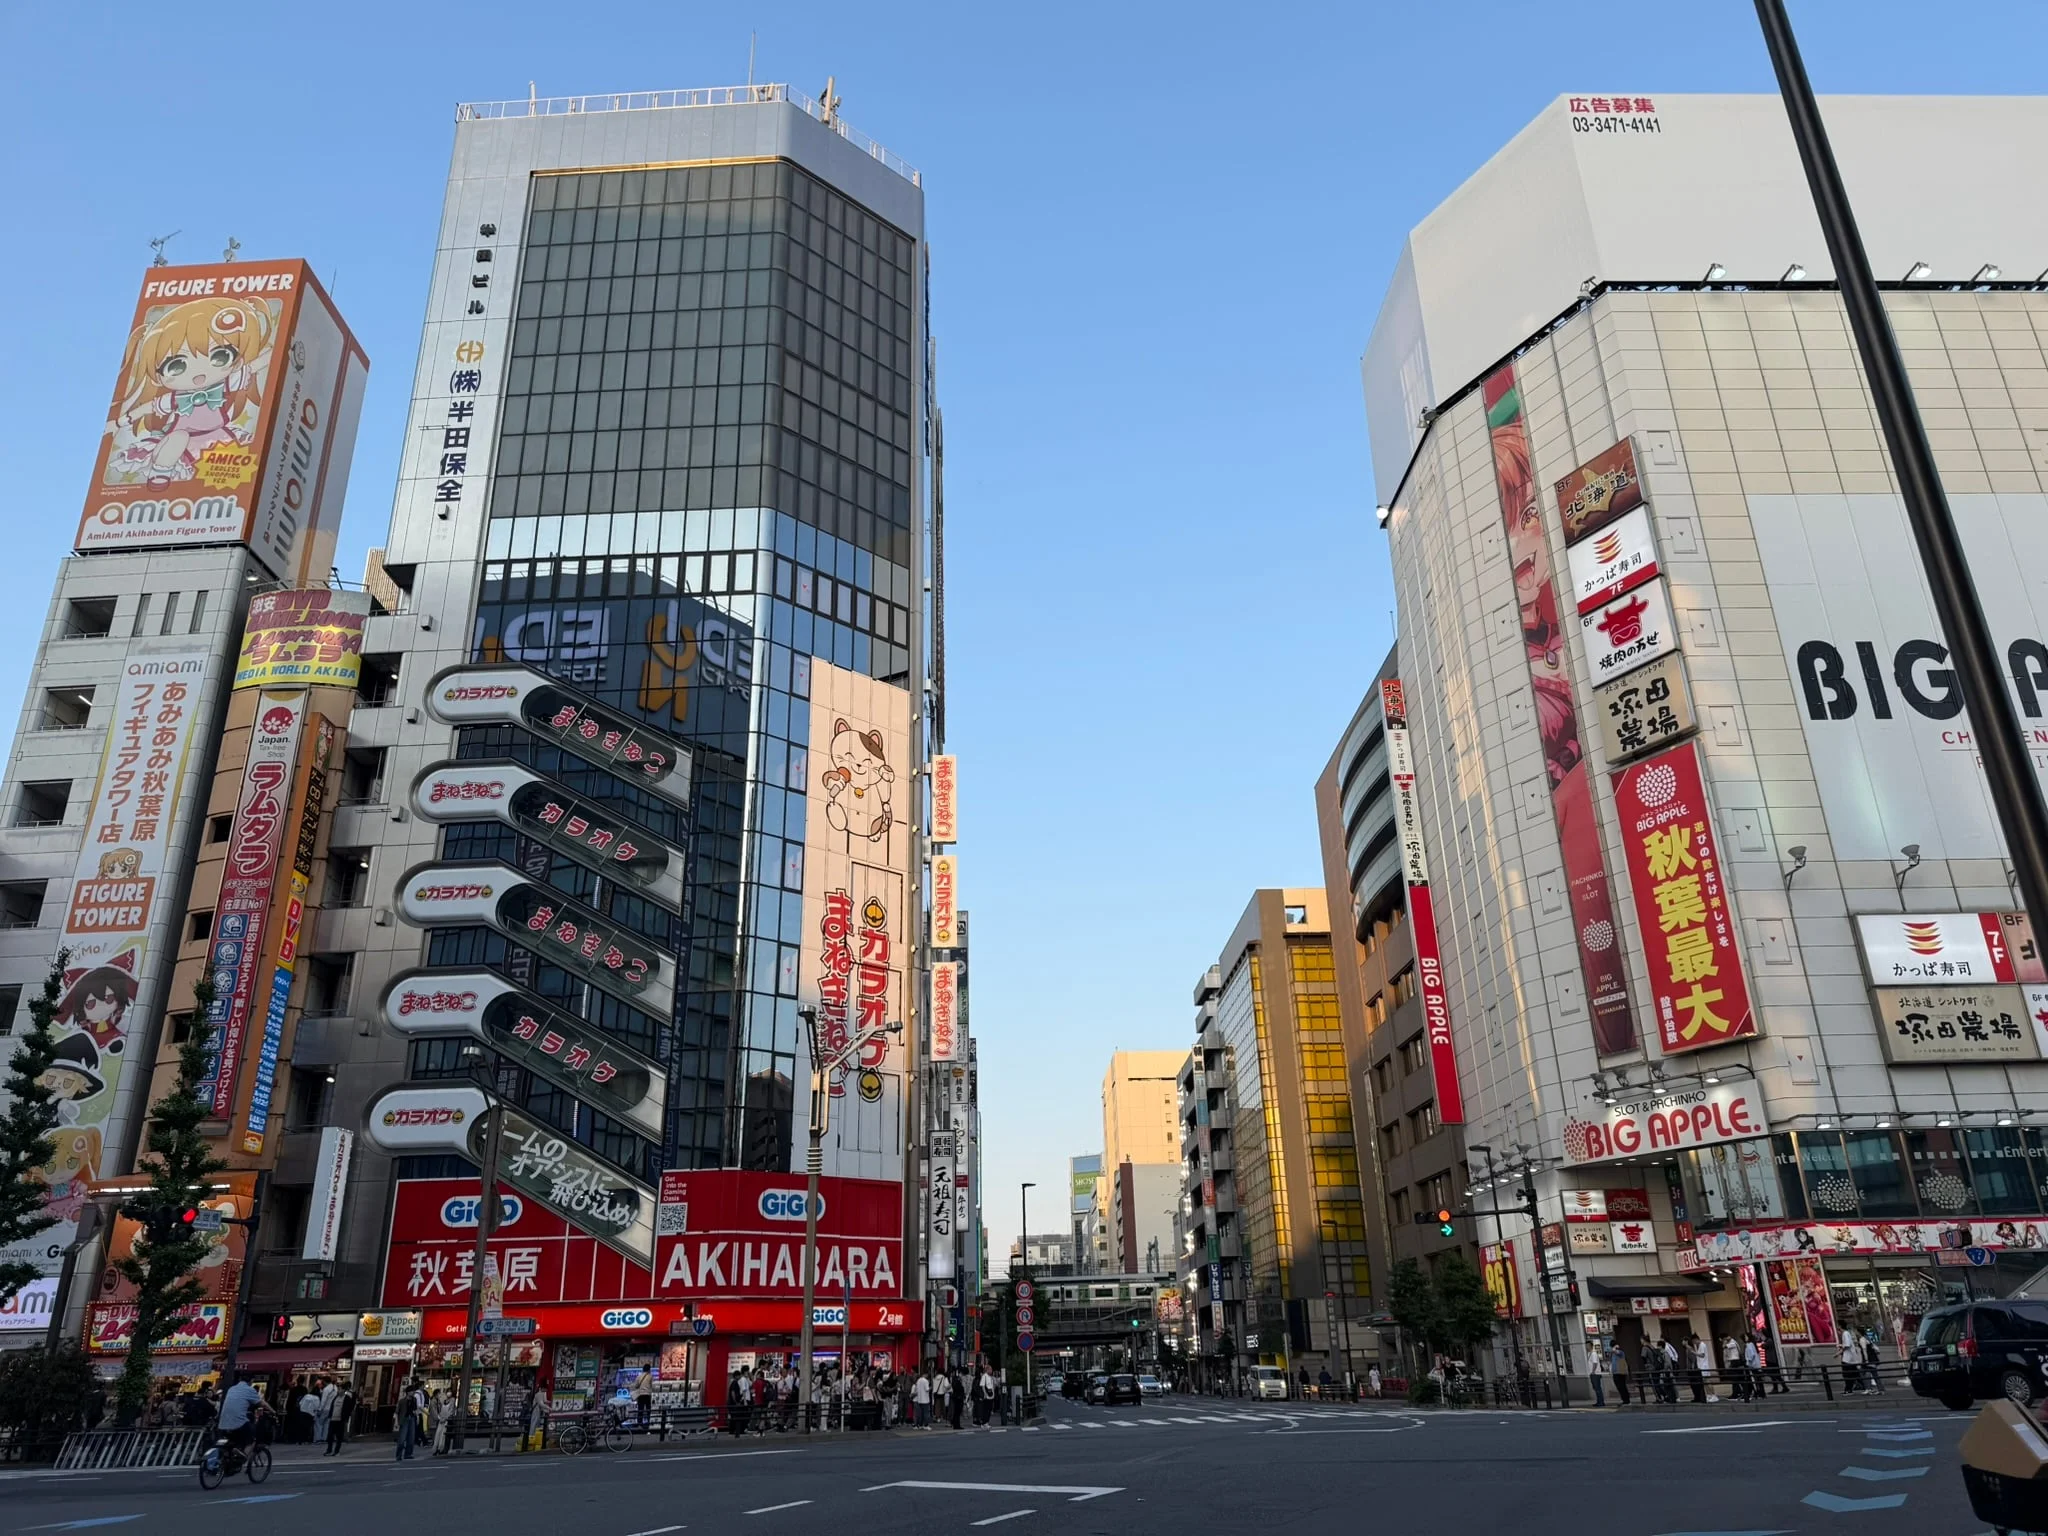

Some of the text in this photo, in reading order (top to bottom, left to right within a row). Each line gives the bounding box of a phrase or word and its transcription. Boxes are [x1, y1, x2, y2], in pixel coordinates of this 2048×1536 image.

[1569, 97, 1656, 113] 広告募集
[1572, 116, 1661, 133] 03-3471-4141
[145, 273, 294, 299] FIGURE TOWER
[205, 452, 252, 468] AMICO
[1556, 478, 1573, 494] 8F
[1565, 472, 1630, 520] 北海道
[100, 497, 237, 525] amiami
[86, 524, 236, 541] AmiAmi Akihabara Figure Tower
[1584, 552, 1642, 593] かっぱ寿司
[1609, 581, 1624, 596] 7F
[277, 589, 332, 610] DVD
[300, 611, 367, 630] BOOK
[1583, 615, 1594, 628] 6F
[251, 644, 343, 666] ラムタラ
[128, 658, 204, 676] amiami
[236, 665, 356, 682] MEDIA WORLD AKIBA
[1797, 639, 1967, 721] BIG
[455, 685, 507, 701] カラオケ
[551, 704, 667, 774] まねきねこ
[96, 682, 156, 845] フィギュアタワー店
[129, 680, 188, 842] あみあみ秋葉原
[266, 751, 286, 759] Shop
[309, 785, 321, 800] CD
[428, 781, 505, 804] まねきねこ
[933, 757, 955, 839] まねきねこ
[231, 760, 287, 876] ラムタラ
[1636, 806, 1691, 833] BIG APPLE.
[538, 801, 639, 862] カラオケ
[1571, 870, 1604, 888] PACHINKO
[79, 881, 147, 904] FIGURE
[426, 885, 482, 901] カラオケ
[935, 872, 953, 929] カラオケ
[1582, 890, 1599, 902] SLOT
[74, 905, 141, 928] TOWER
[2004, 914, 2024, 926] 8F
[278, 897, 303, 963] DVD
[1642, 823, 1731, 1042] 秋葉最大
[526, 906, 649, 984] まねきねこ
[1599, 973, 1613, 983] BIG
[1893, 961, 1973, 977] かっぱ寿司
[398, 990, 477, 1017] まねきねこ
[817, 887, 854, 1100] まねきねこ
[857, 924, 890, 1068] カラオケ
[1420, 956, 1450, 1046] BIG APPLE
[1899, 995, 1935, 1009] 北海道
[933, 964, 954, 1059] まねきねこ
[1659, 995, 1679, 1045] 設置台数
[1895, 1010, 2022, 1045] 塚田農場
[512, 1015, 618, 1084] カラオケ
[1614, 1090, 1707, 1118] SLOT & PACHINKO
[394, 1109, 455, 1125] カラオケ
[1584, 1118, 1642, 1160] BIG
[507, 1151, 615, 1196] オアシスに
[663, 1188, 687, 1197] Gaming
[932, 1165, 952, 1236] 元祖寿司
[1671, 1187, 1681, 1200] 3F
[548, 1182, 641, 1230] 飛び込め!
[1675, 1207, 1684, 1219] 2F
[1678, 1224, 1688, 1238] 1F
[1020, 1286, 1029, 1294] 40
[386, 1315, 418, 1327] Pepper
[603, 1310, 651, 1327] GiGO
[813, 1308, 846, 1324] GiGO
[877, 1306, 903, 1326] 2号館
[1779, 1317, 1806, 1334] 860
[384, 1325, 416, 1336] Lunch
[446, 1324, 457, 1333] Get
